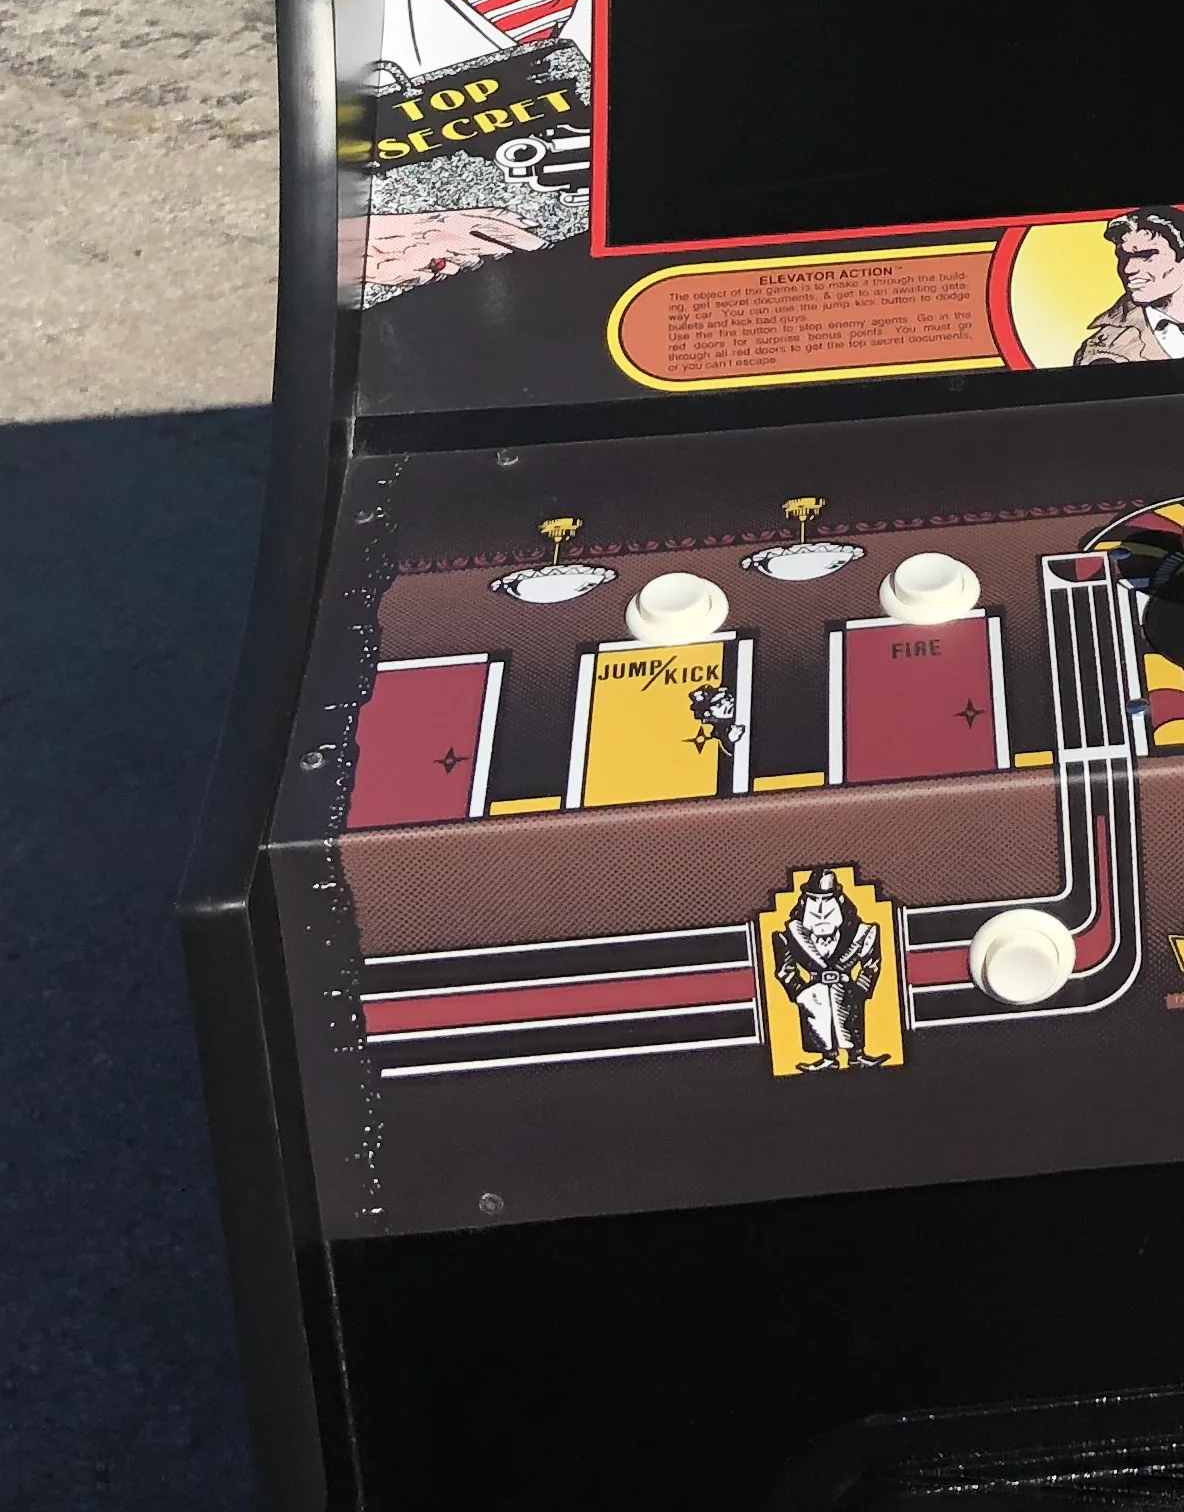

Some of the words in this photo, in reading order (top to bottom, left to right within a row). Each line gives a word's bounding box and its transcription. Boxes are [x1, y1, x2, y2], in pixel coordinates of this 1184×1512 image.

[392, 79, 500, 121] TOP
[377, 89, 572, 160] SECRET
[669, 292, 690, 301] The
[693, 289, 726, 301] object
[730, 288, 741, 297] of
[766, 286, 798, 296] game
[829, 279, 859, 289] make
[873, 275, 914, 286] through
[918, 273, 935, 282] the
[760, 271, 835, 286] ELEVATOR
[823, 291, 831, 300] &
[859, 289, 869, 297] to
[669, 314, 690, 322] way
[721, 309, 744, 317] You
[801, 302, 817, 311] the
[881, 296, 915, 305] button
[921, 294, 931, 302] to
[936, 292, 970, 302] dodge
[669, 333, 690, 341] Use
[696, 330, 713, 339] the
[743, 326, 777, 336] button
[783, 324, 793, 333] to
[799, 323, 822, 332] stop
[828, 321, 866, 329] enemy
[917, 314, 934, 322] Go
[707, 319, 727, 328] and
[756, 315, 776, 325] bad
[668, 342, 686, 352] red
[694, 341, 725, 350] doors
[733, 338, 747, 347] for
[808, 332, 842, 341] bonus
[895, 326, 916, 334] You
[924, 322, 950, 332] must
[668, 350, 710, 361] through
[715, 349, 728, 358] all
[732, 347, 750, 357] red
[790, 344, 801, 352] to
[806, 342, 823, 353] get
[828, 341, 844, 349] the
[682, 363, 702, 373] you
[891, 639, 942, 660] FIRE
